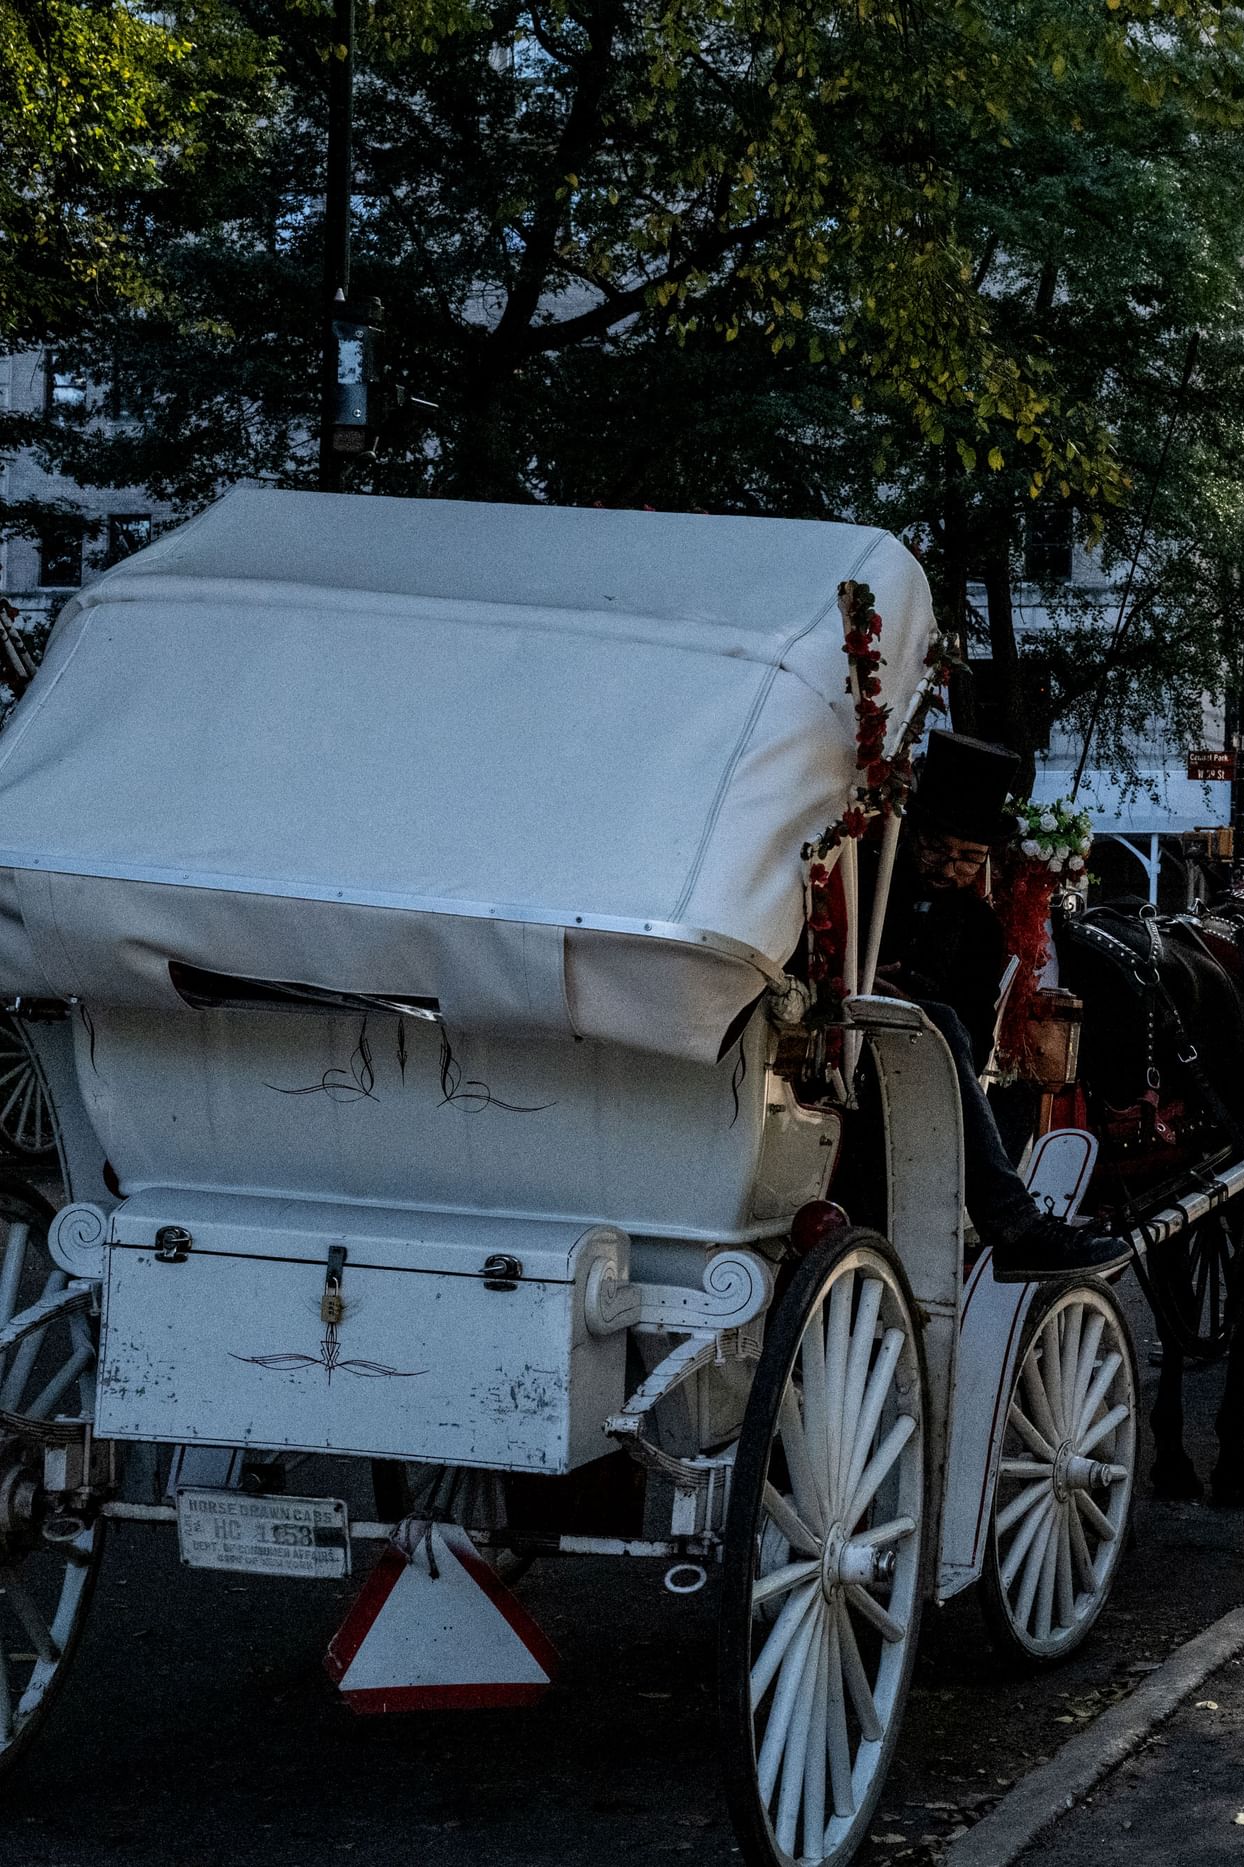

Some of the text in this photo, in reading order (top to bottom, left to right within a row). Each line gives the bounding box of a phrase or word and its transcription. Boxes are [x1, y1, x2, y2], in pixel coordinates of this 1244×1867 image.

[1213, 753, 1229, 761] Park
[188, 1499, 333, 1523] HORSE DRAWN CABS
[214, 1518, 241, 1540] HC
